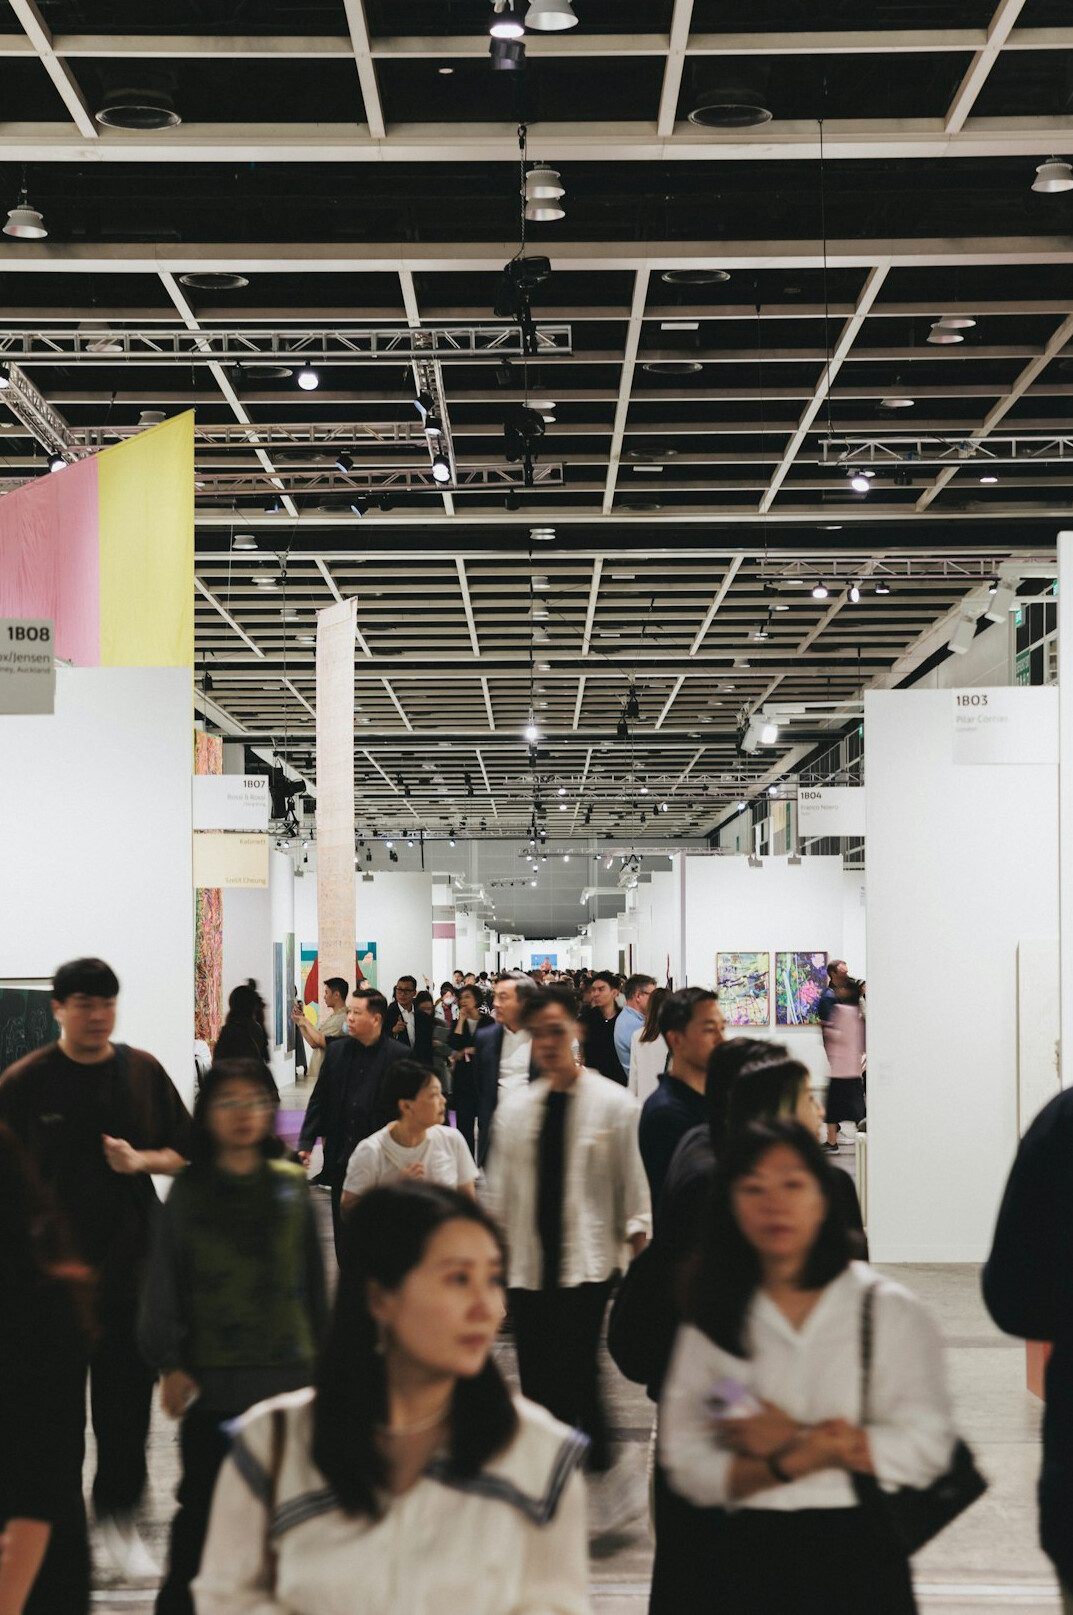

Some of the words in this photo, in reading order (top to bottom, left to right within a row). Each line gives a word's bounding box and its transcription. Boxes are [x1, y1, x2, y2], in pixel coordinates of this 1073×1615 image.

[8, 626, 50, 641] 1B08
[957, 694, 988, 706] 1B03
[243, 780, 266, 788] 1B07
[801, 791, 822, 799] 1B04
